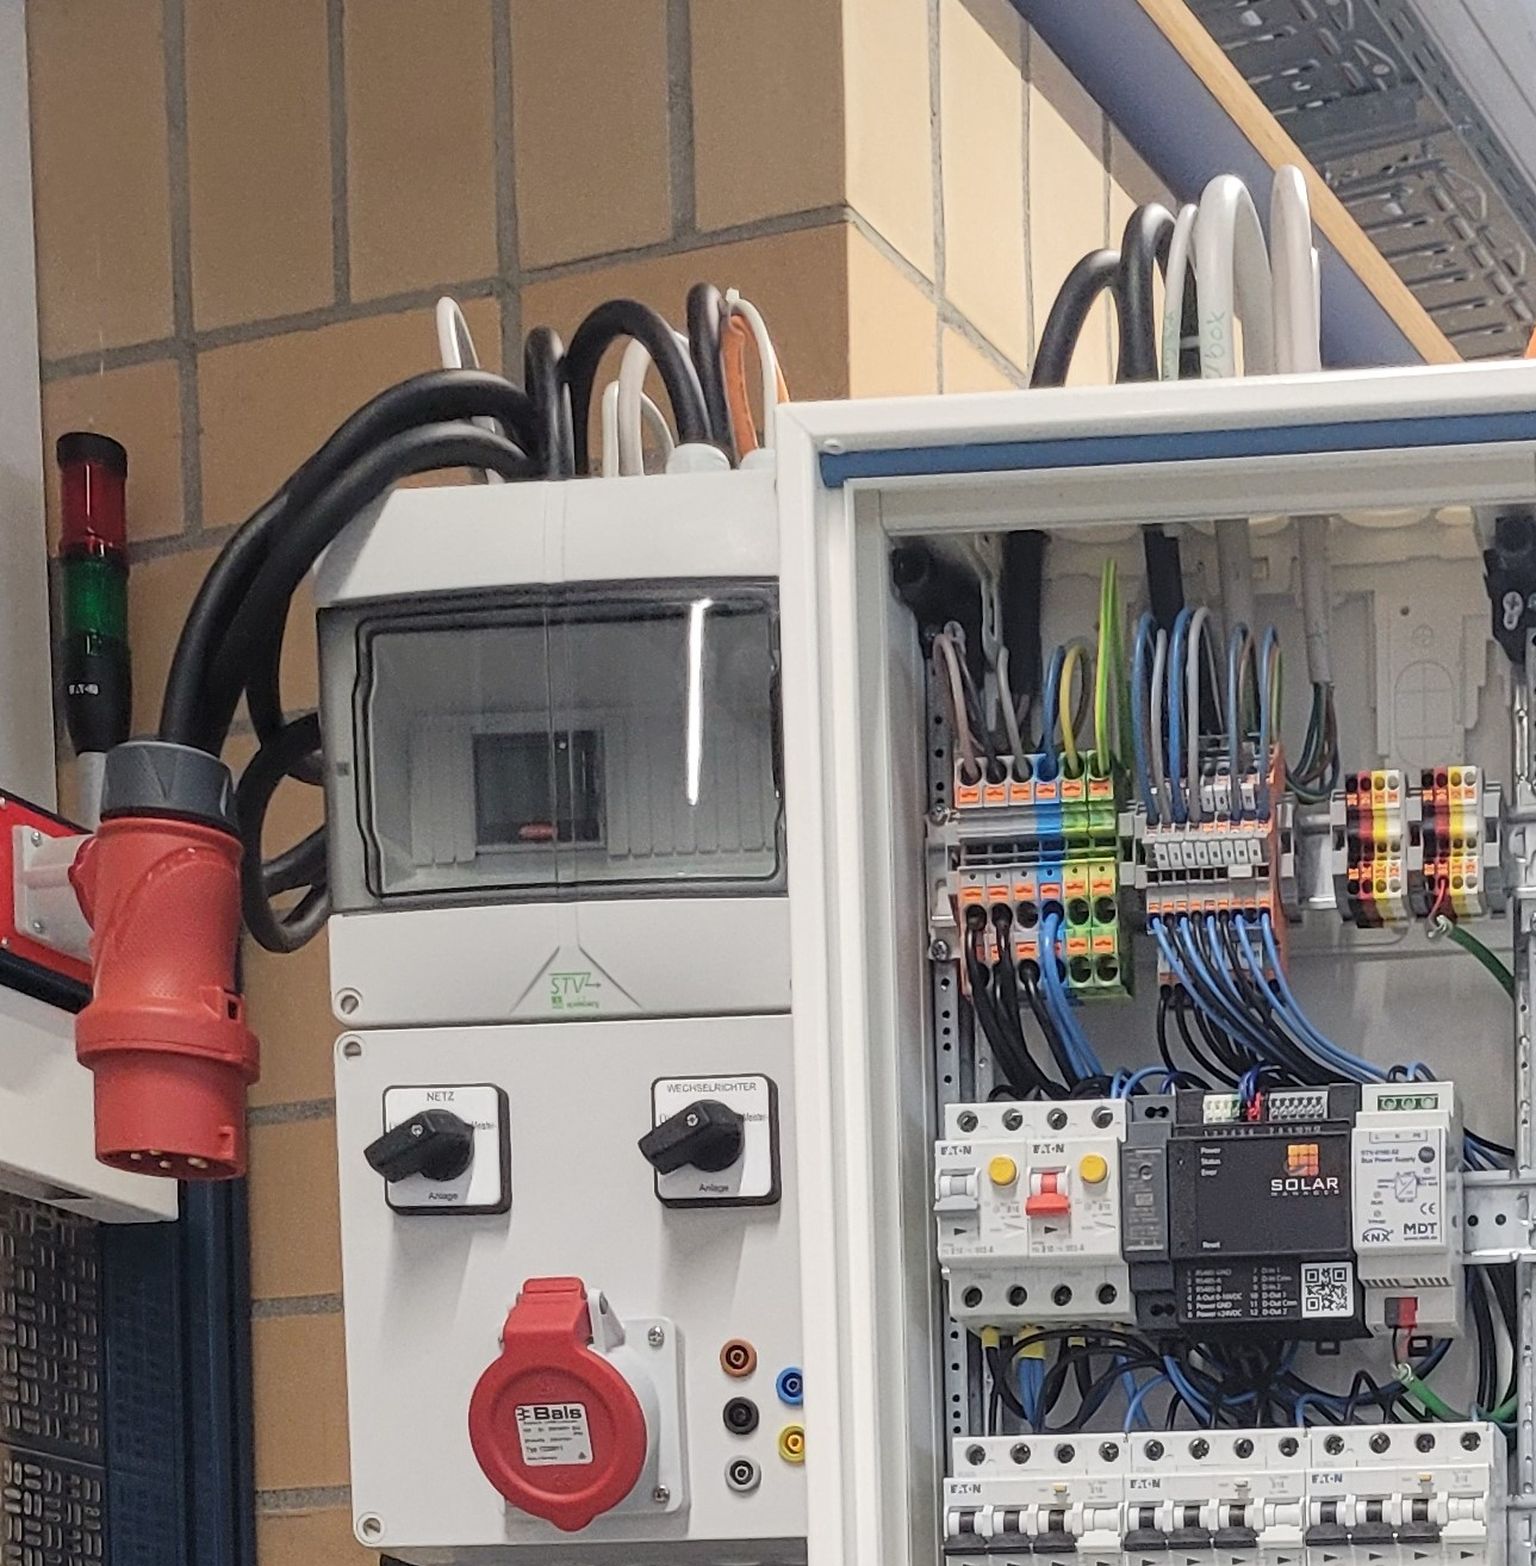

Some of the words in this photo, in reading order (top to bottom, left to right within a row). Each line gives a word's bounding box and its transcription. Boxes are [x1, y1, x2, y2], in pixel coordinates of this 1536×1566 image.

[667, 1082, 757, 1093] WECHSELRICHTER
[426, 1091, 455, 1102] NETZ
[699, 1183, 729, 1193] Anlage
[1270, 1177, 1339, 1192] SOLAR
[1403, 1223, 1438, 1235] MDT
[1362, 1233, 1391, 1242] KNX
[533, 1406, 582, 1420] Bals
